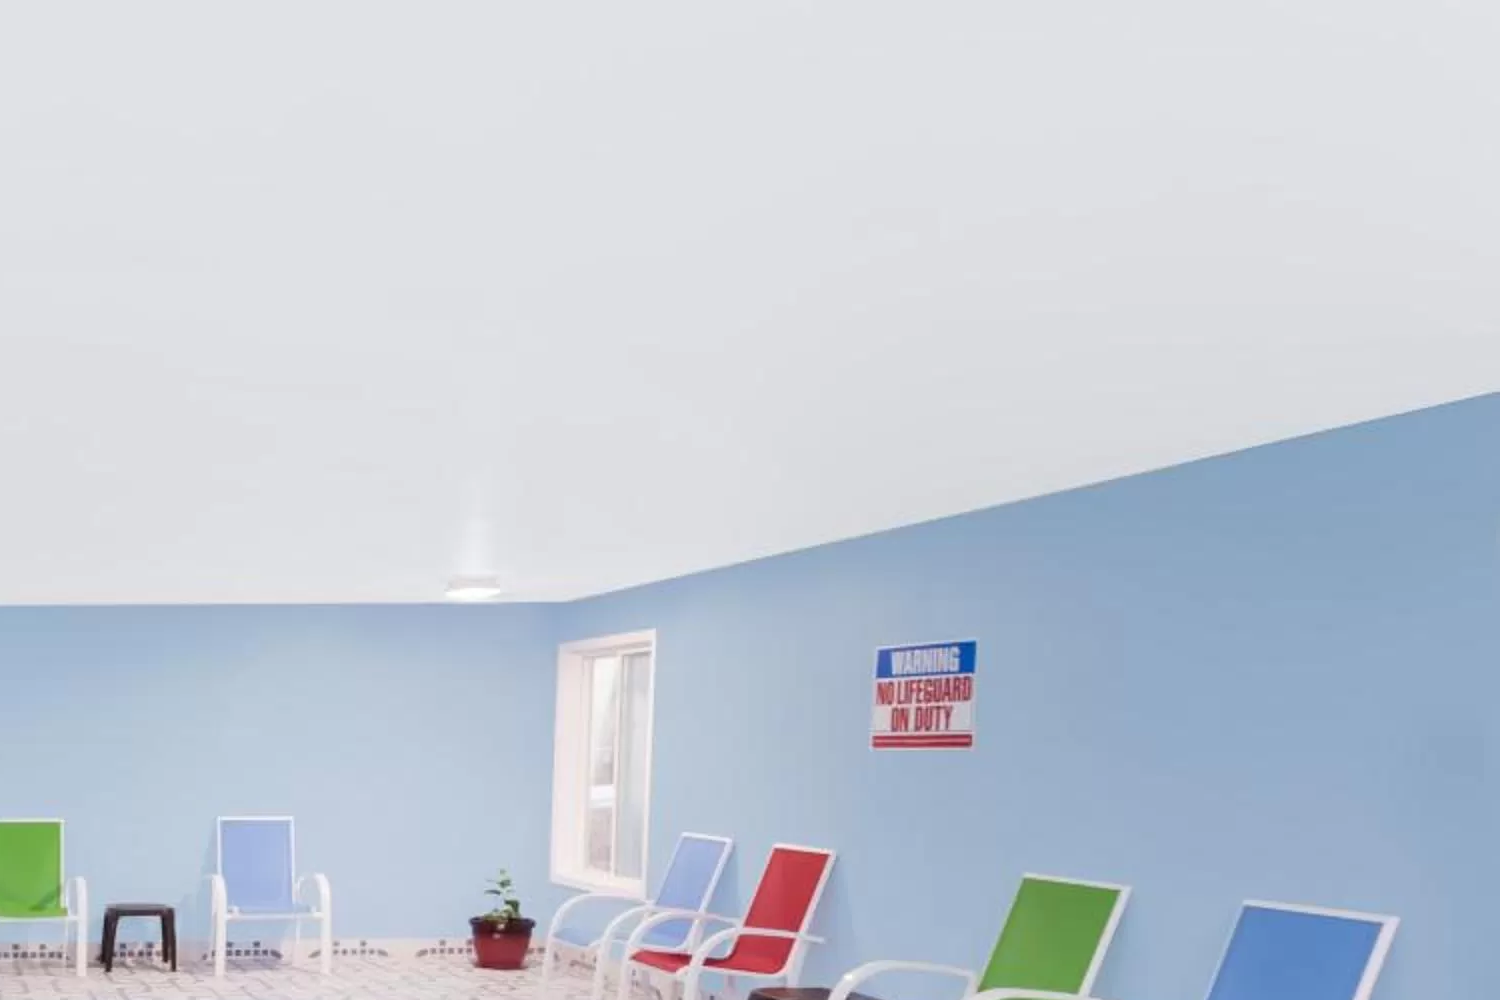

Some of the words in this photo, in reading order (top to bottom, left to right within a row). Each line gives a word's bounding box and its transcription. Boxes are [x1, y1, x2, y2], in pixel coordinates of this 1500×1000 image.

[891, 646, 961, 676] WARNING
[876, 681, 895, 705] NO
[897, 676, 972, 704] LIFEGUARD
[891, 707, 909, 732] ON
[914, 705, 953, 731] DUTY
